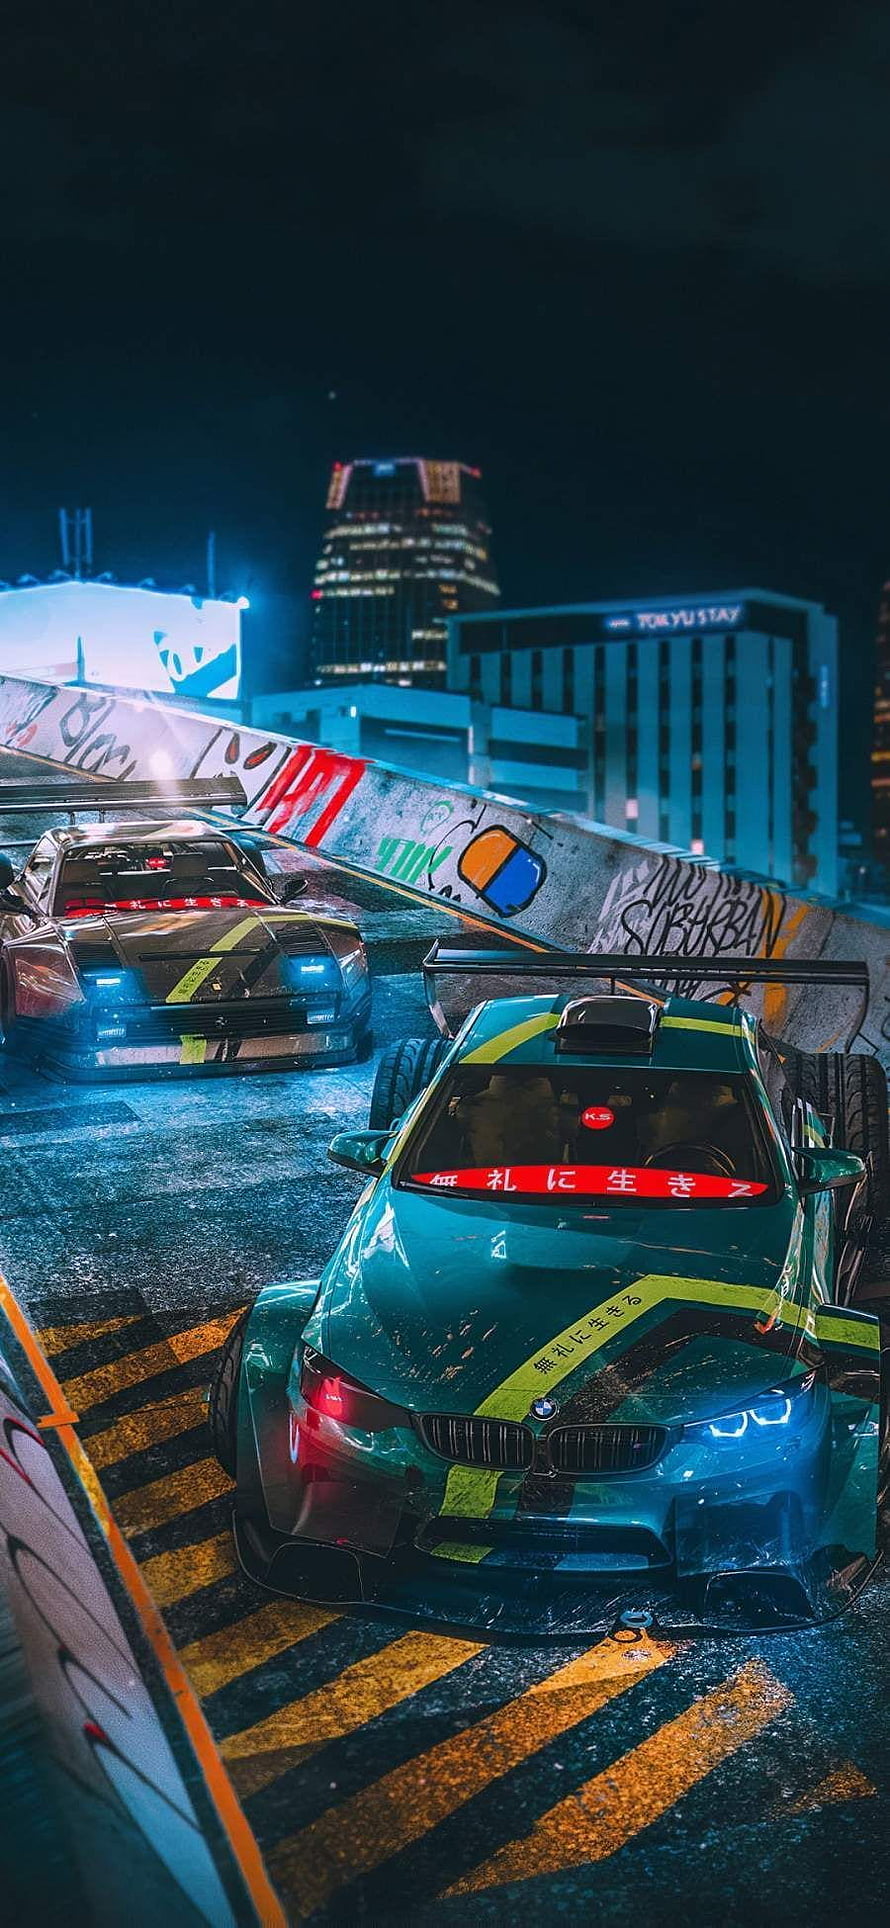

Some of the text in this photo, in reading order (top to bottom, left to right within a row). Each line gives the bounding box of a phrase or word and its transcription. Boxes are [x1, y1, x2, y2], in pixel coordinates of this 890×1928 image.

[697, 606, 740, 625] STAY
[533, 1295, 642, 1375] 無礼に生きる
